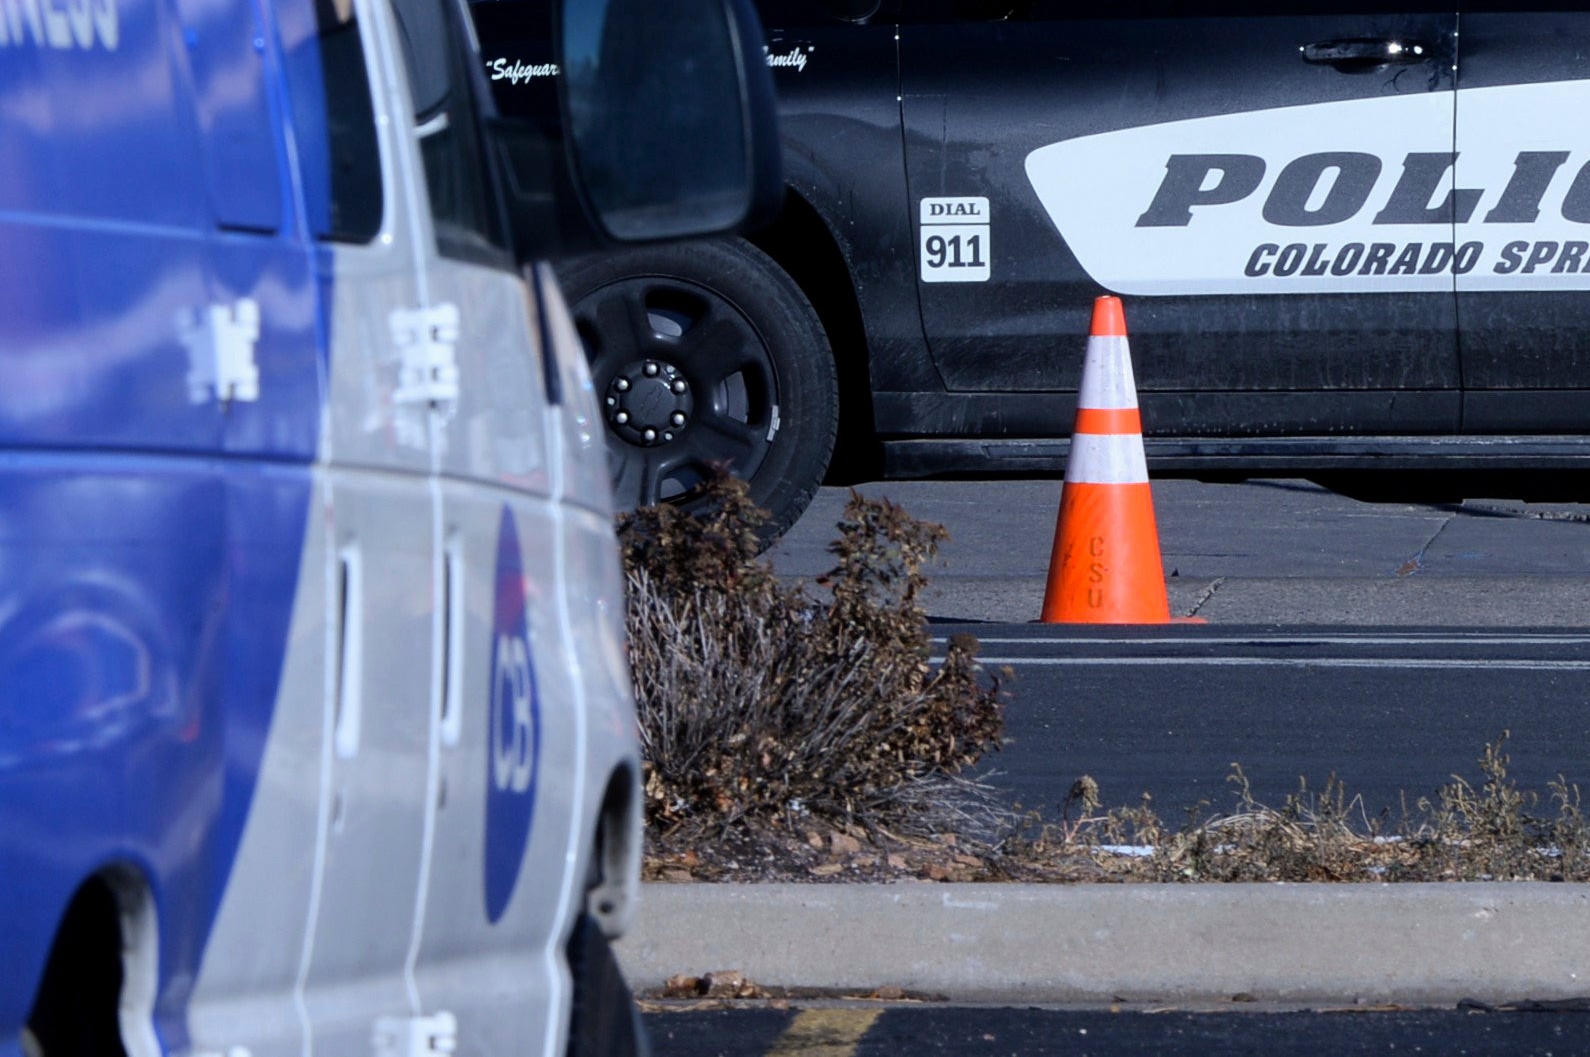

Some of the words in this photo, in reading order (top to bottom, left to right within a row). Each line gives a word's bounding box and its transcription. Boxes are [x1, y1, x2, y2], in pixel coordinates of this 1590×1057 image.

[486, 57, 561, 86] "Safeguar
[929, 202, 981, 216] DIAL
[925, 234, 986, 269] 911
[1243, 240, 1485, 278] COLORADO
